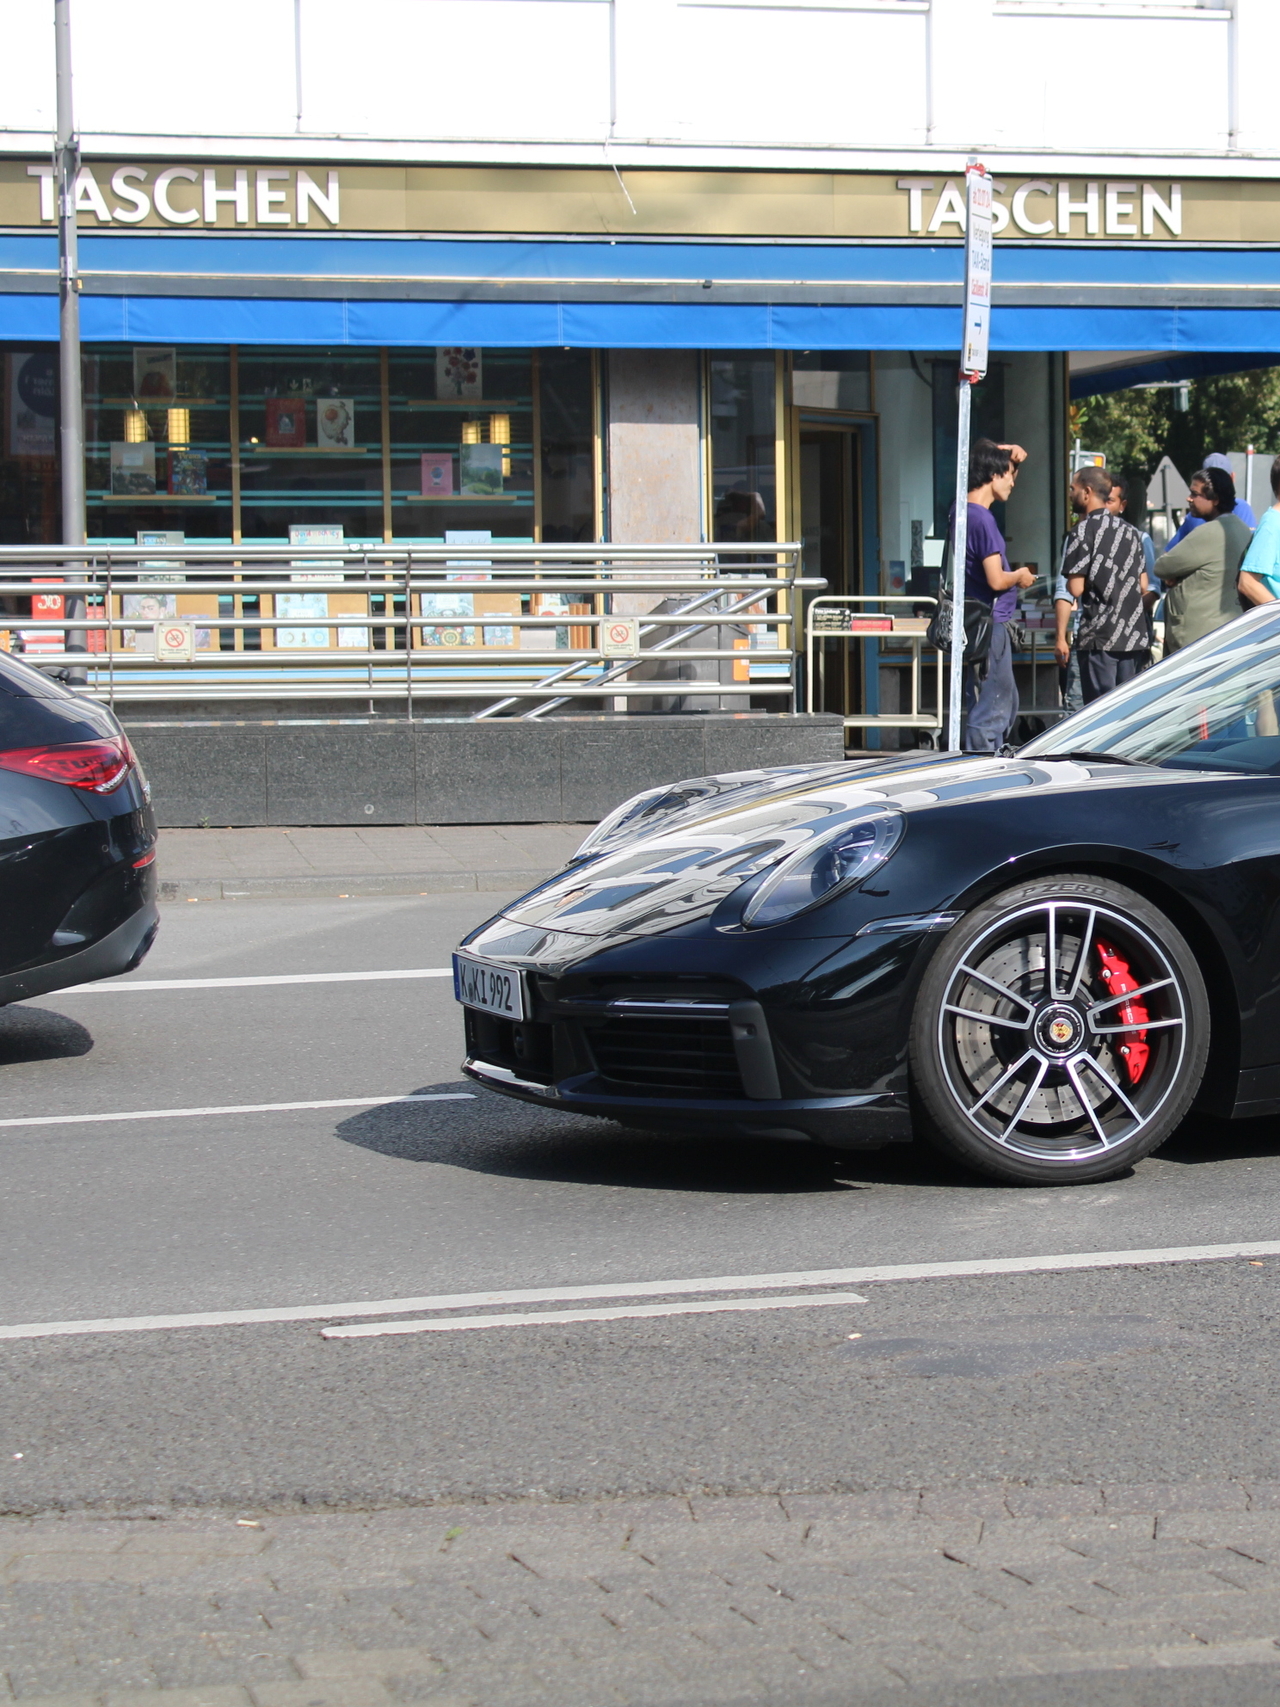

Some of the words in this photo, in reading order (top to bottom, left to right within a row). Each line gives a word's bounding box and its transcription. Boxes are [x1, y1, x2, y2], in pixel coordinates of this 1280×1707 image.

[27, 166, 340, 225] TASCHEN
[1022, 887, 1036, 898] P
[1041, 883, 1108, 896] ZERO
[460, 962, 468, 998] K
[490, 972, 513, 1012] 992
